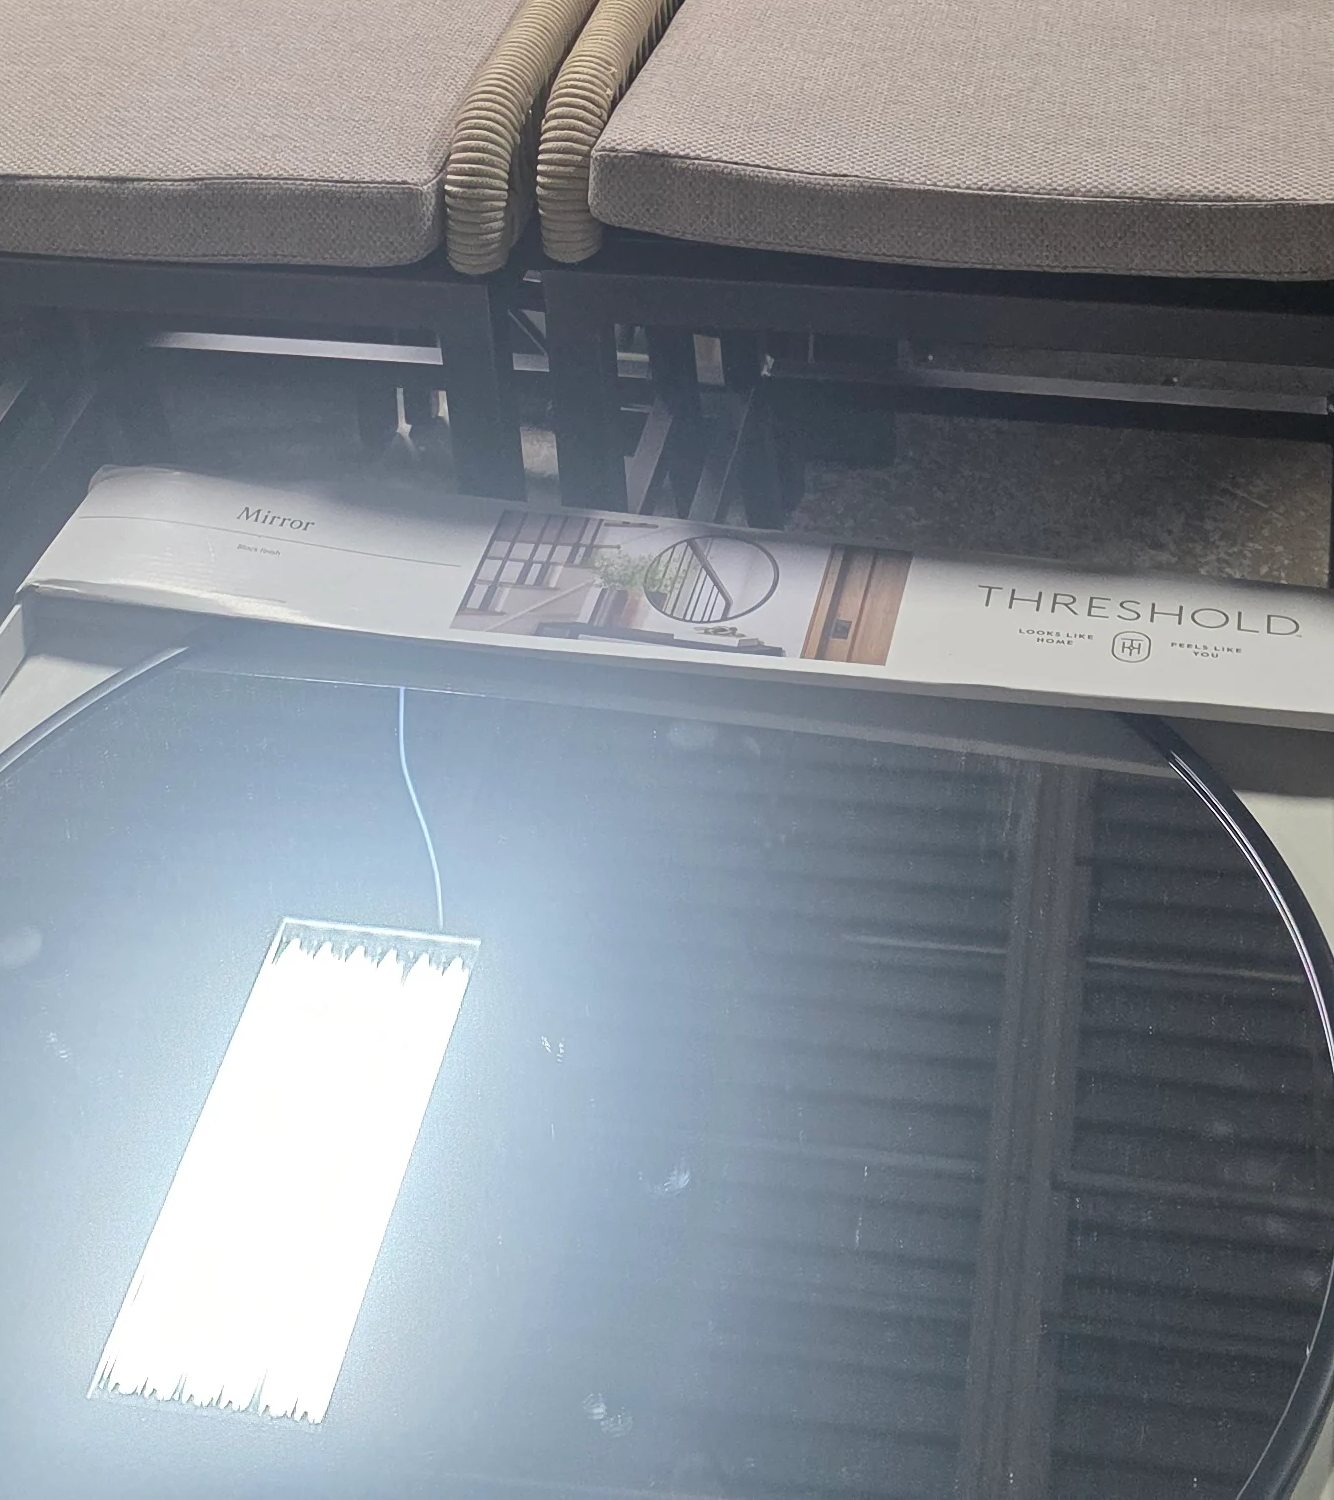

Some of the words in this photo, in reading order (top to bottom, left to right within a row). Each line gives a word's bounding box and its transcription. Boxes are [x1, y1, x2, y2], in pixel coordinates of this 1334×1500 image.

[235, 505, 316, 533] Mirror
[977, 584, 1301, 637] THRESHOLD
[1018, 628, 1062, 638] LOOKS
[1066, 632, 1095, 641] LIKE
[1036, 637, 1074, 646] HOME
[1170, 641, 1209, 651] FEELS
[1213, 646, 1243, 654] LIKE
[1192, 651, 1220, 659] YOU
